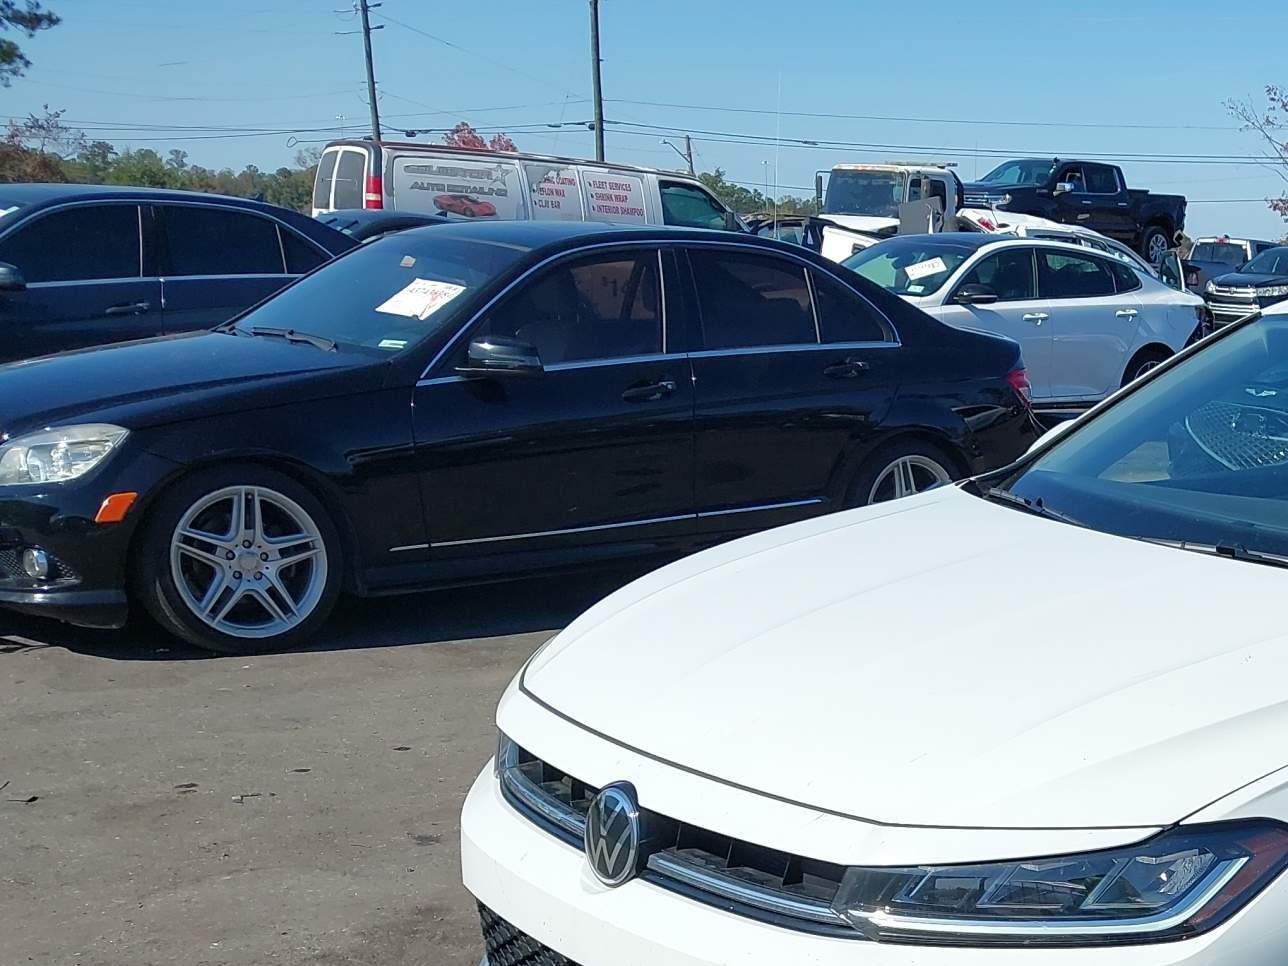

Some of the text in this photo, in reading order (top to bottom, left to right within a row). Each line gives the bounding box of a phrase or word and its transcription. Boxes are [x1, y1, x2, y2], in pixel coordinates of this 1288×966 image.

[409, 181, 446, 193] AUTO
[592, 180, 632, 192] FLEET SERVICES
[595, 193, 628, 203] SHRINK WRAP
[596, 204, 644, 217] INTERIOR SHAMPOO
